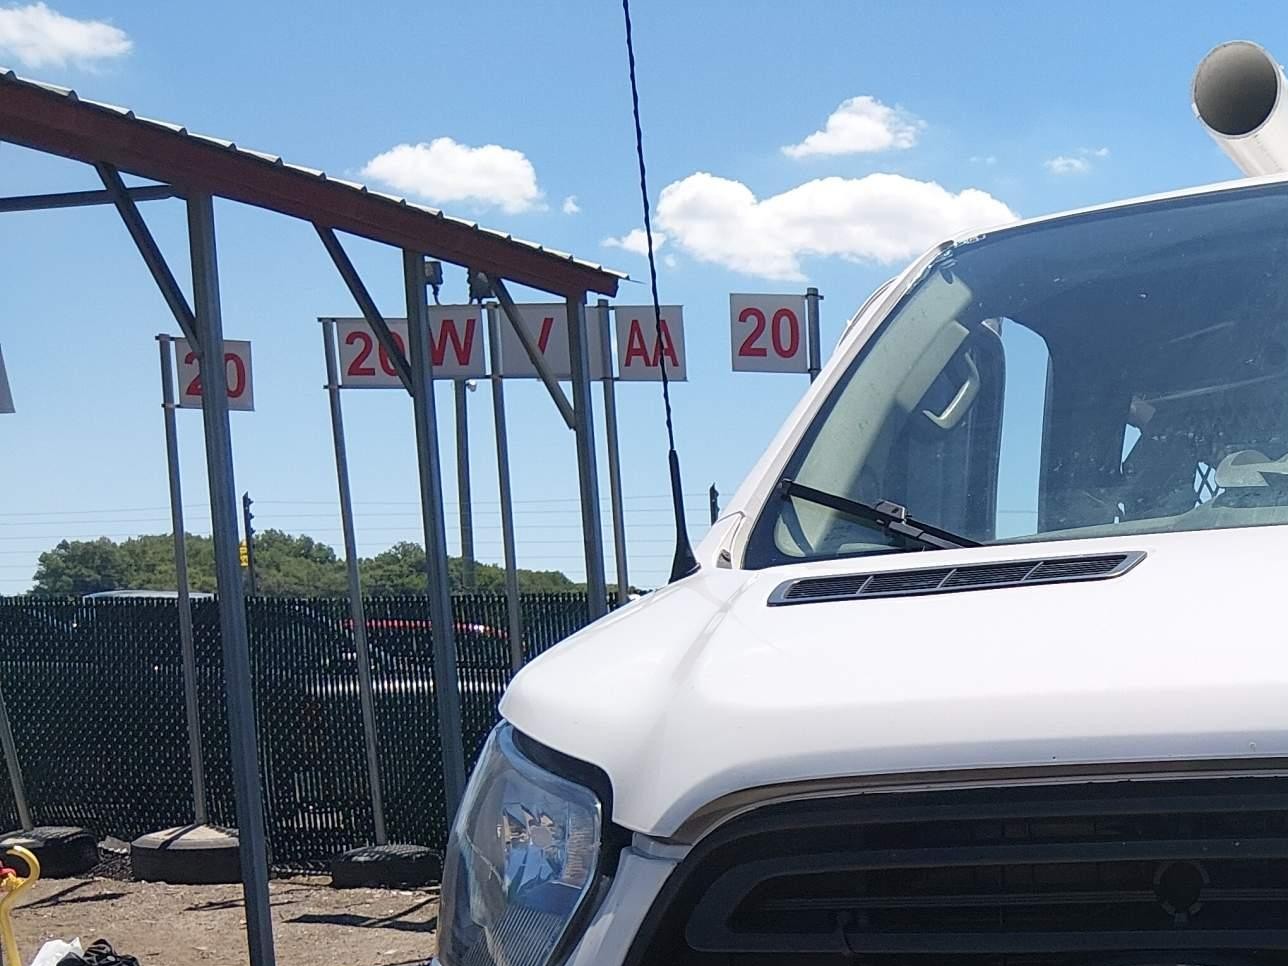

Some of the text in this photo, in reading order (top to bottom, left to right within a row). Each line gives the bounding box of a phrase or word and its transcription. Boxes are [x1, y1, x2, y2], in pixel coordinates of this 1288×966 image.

[345, 330, 406, 377] 20
[428, 318, 477, 366] W
[623, 318, 680, 368] AA
[737, 307, 801, 359] 20
[183, 350, 247, 399] 20
